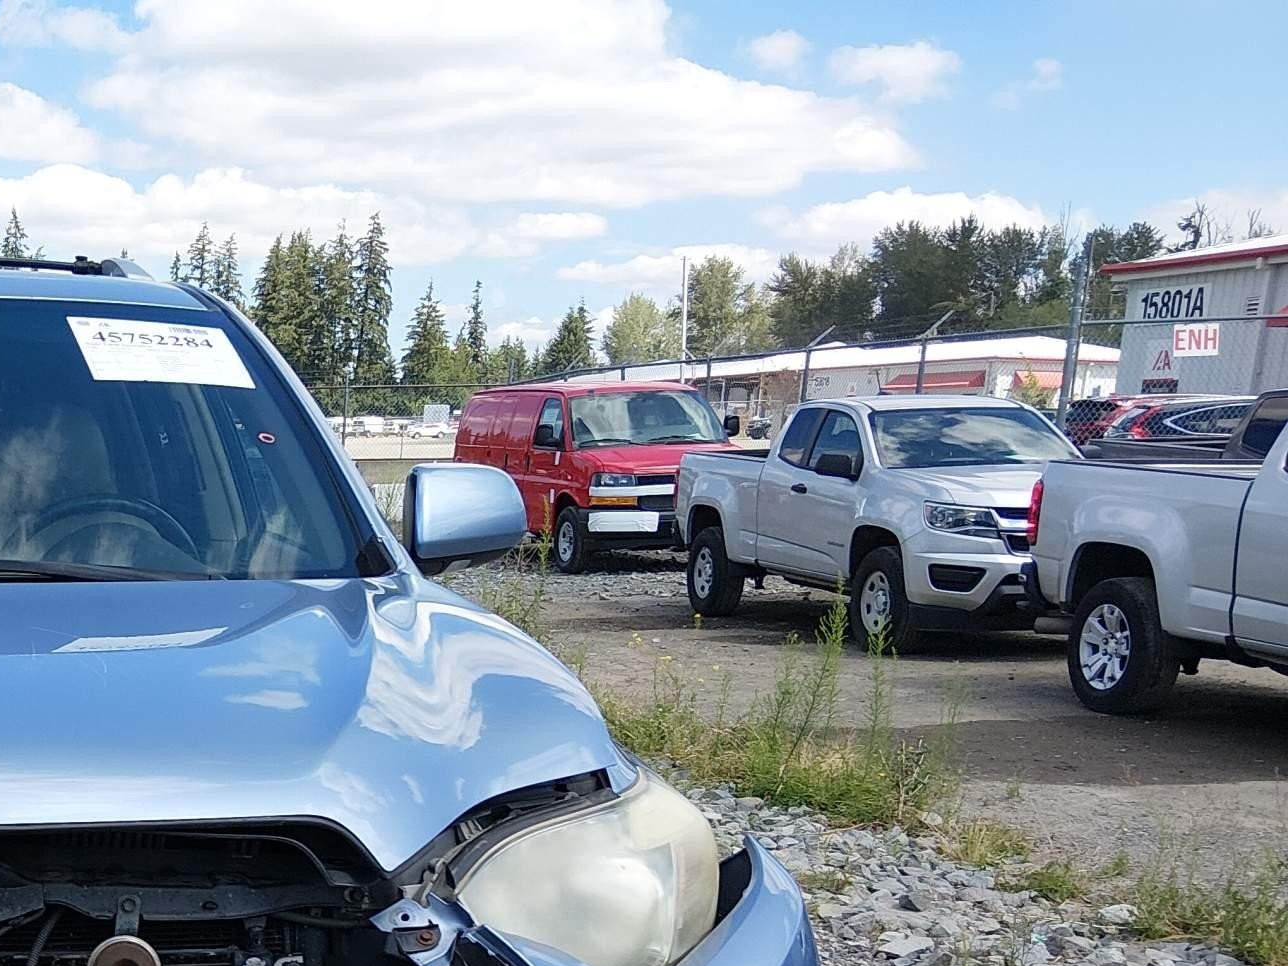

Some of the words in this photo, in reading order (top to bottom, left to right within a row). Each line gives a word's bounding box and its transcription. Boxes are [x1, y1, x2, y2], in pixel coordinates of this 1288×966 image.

[1141, 287, 1204, 319] 15801A
[92, 331, 214, 349] 45752284
[1175, 328, 1217, 350] ENH
